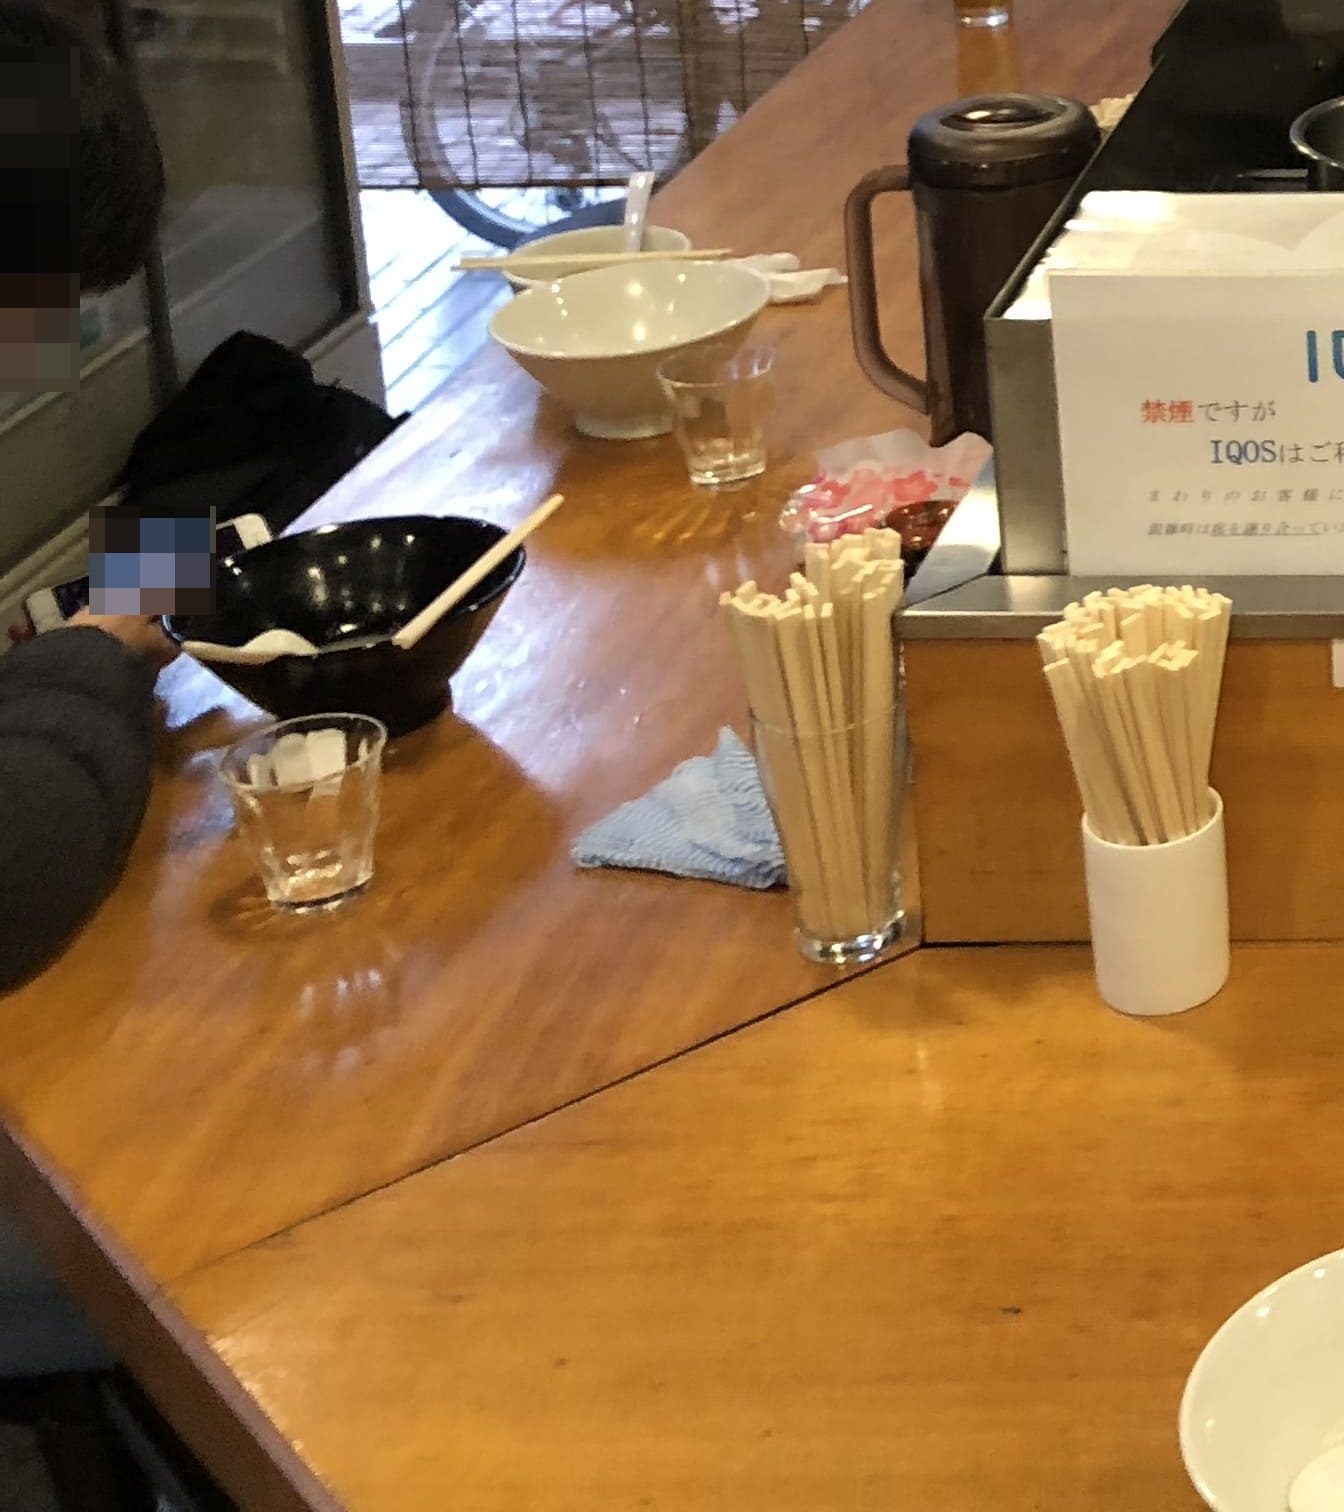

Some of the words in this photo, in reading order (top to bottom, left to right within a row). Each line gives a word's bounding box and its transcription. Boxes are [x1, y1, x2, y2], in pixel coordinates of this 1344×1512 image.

[1140, 399, 1277, 424] 禁煙ですが
